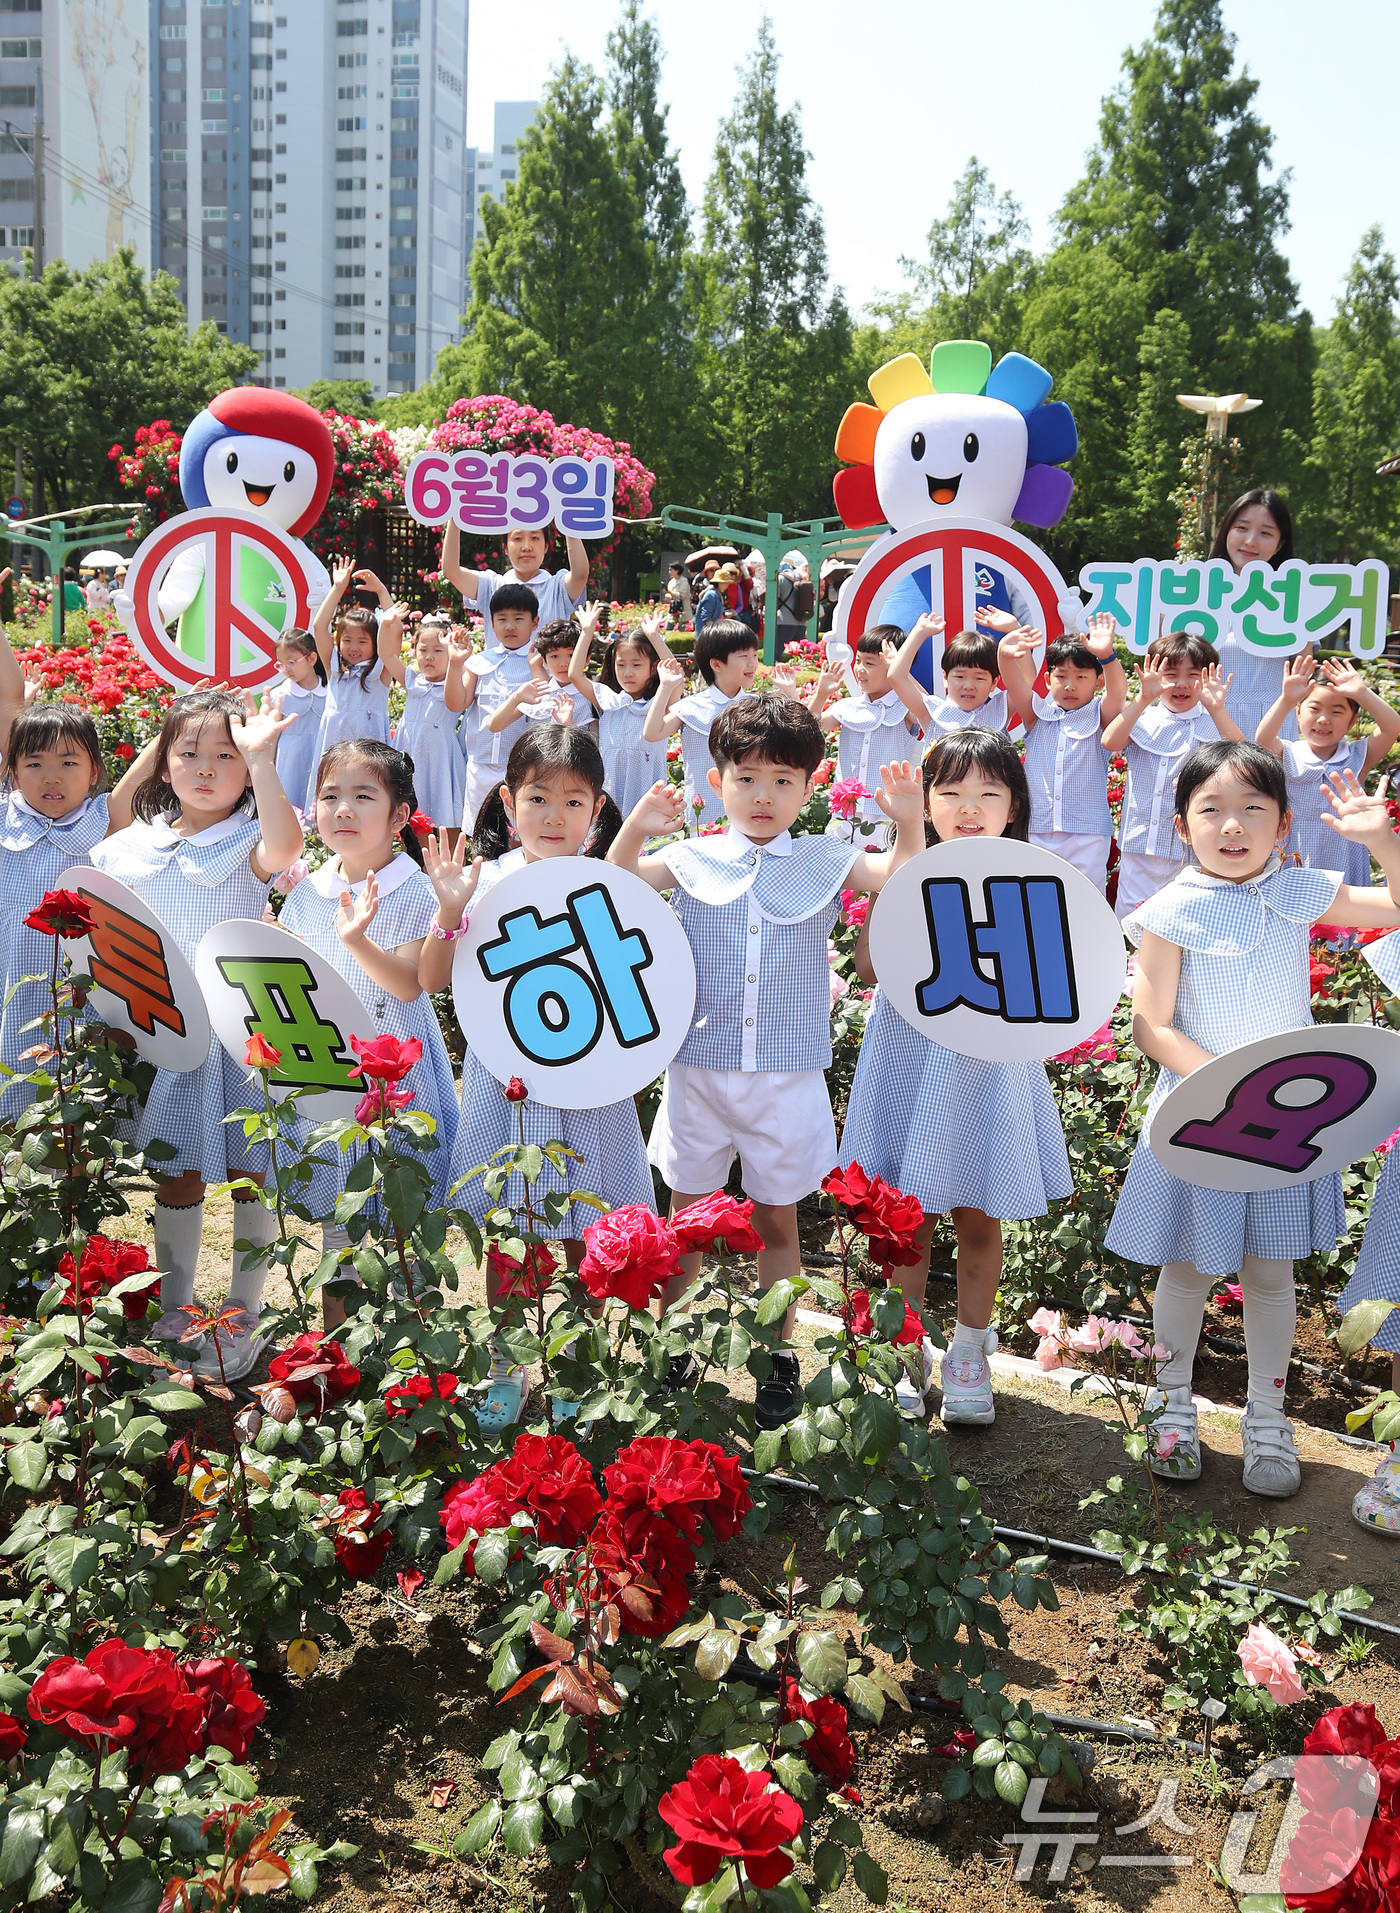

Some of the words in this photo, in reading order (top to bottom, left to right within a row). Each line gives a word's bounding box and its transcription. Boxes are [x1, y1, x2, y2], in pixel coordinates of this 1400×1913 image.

[1085, 566, 1379, 651] 지방선거
[77, 887, 186, 1037] 투
[216, 956, 369, 1093] 표
[477, 882, 660, 1067] 하
[915, 875, 1079, 1023] 세
[1169, 1051, 1377, 1173] 요
